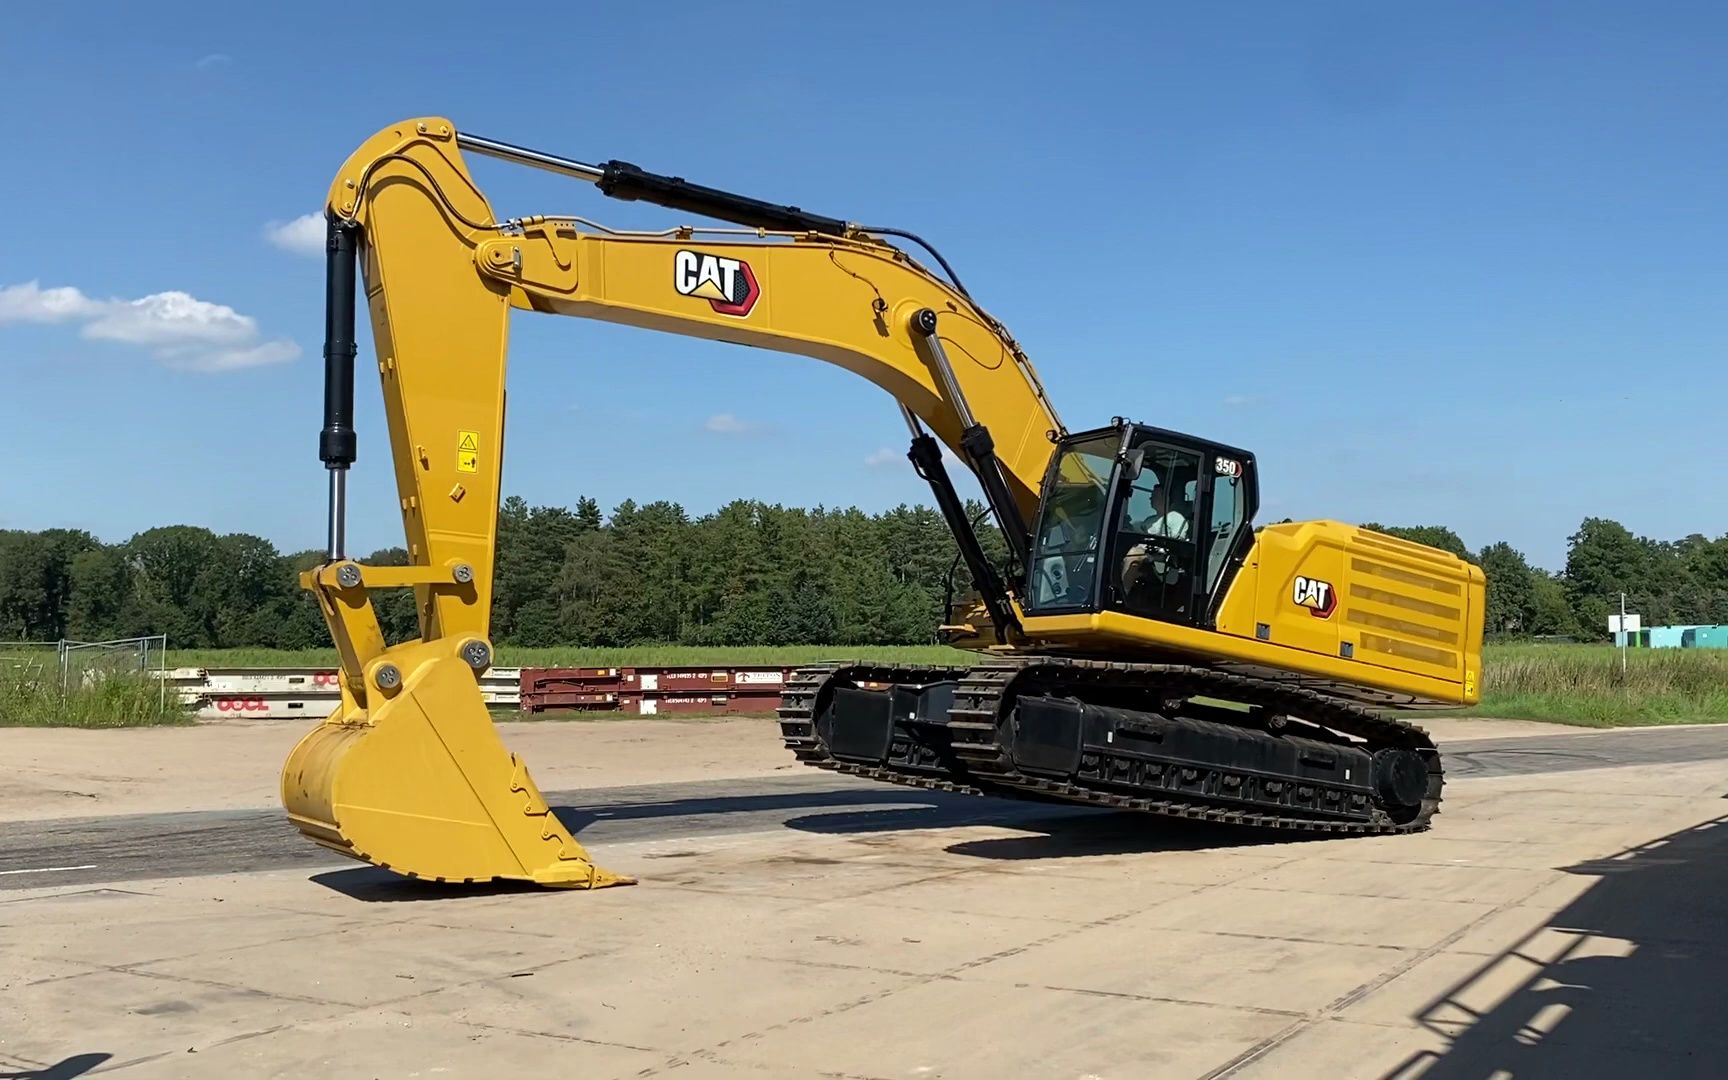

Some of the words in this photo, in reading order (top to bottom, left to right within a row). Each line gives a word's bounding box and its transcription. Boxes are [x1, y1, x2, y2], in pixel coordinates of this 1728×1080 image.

[675, 250, 740, 302] CAT
[1215, 457, 1236, 475] 350
[1294, 576, 1329, 610] CAT
[217, 696, 269, 711] OOCL
